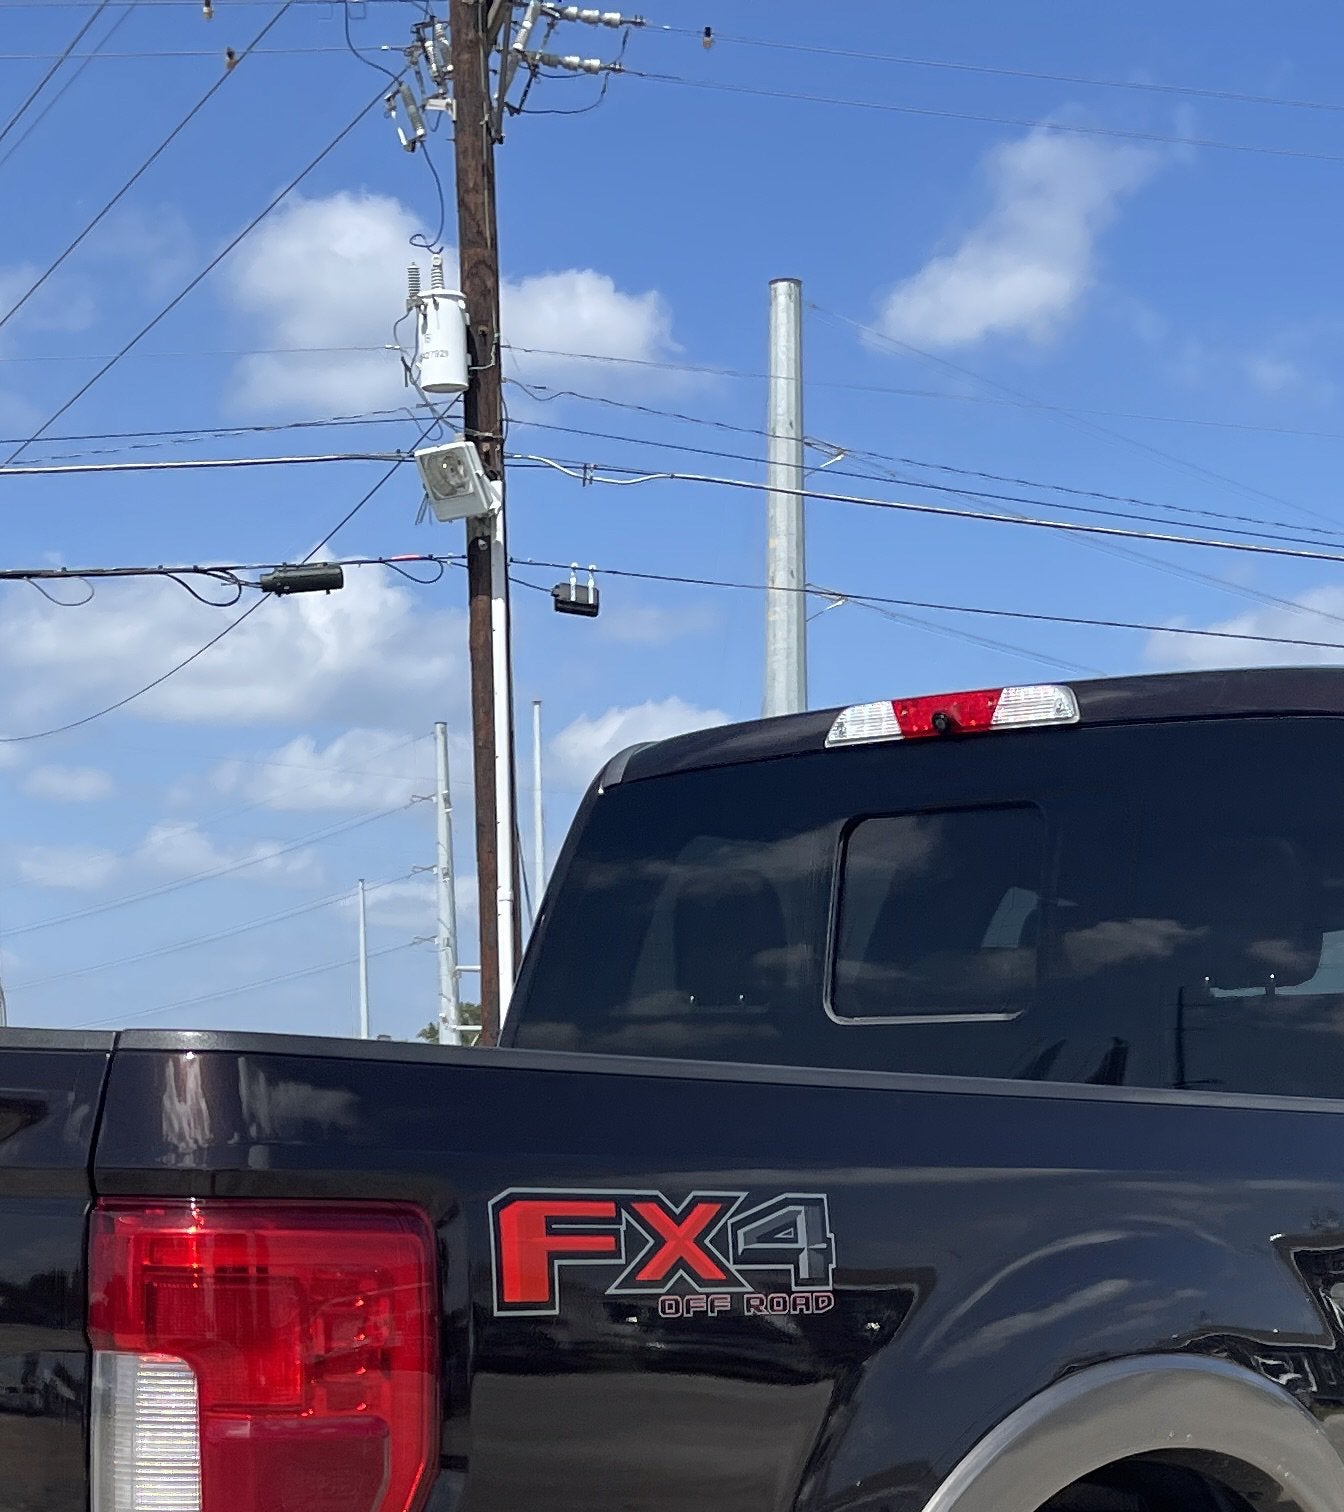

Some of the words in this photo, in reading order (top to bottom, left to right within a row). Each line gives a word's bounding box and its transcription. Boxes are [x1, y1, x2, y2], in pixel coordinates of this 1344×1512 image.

[488, 1187, 836, 1316] FX4
[658, 1294, 732, 1318] OFF
[744, 1292, 835, 1316] ROAD
